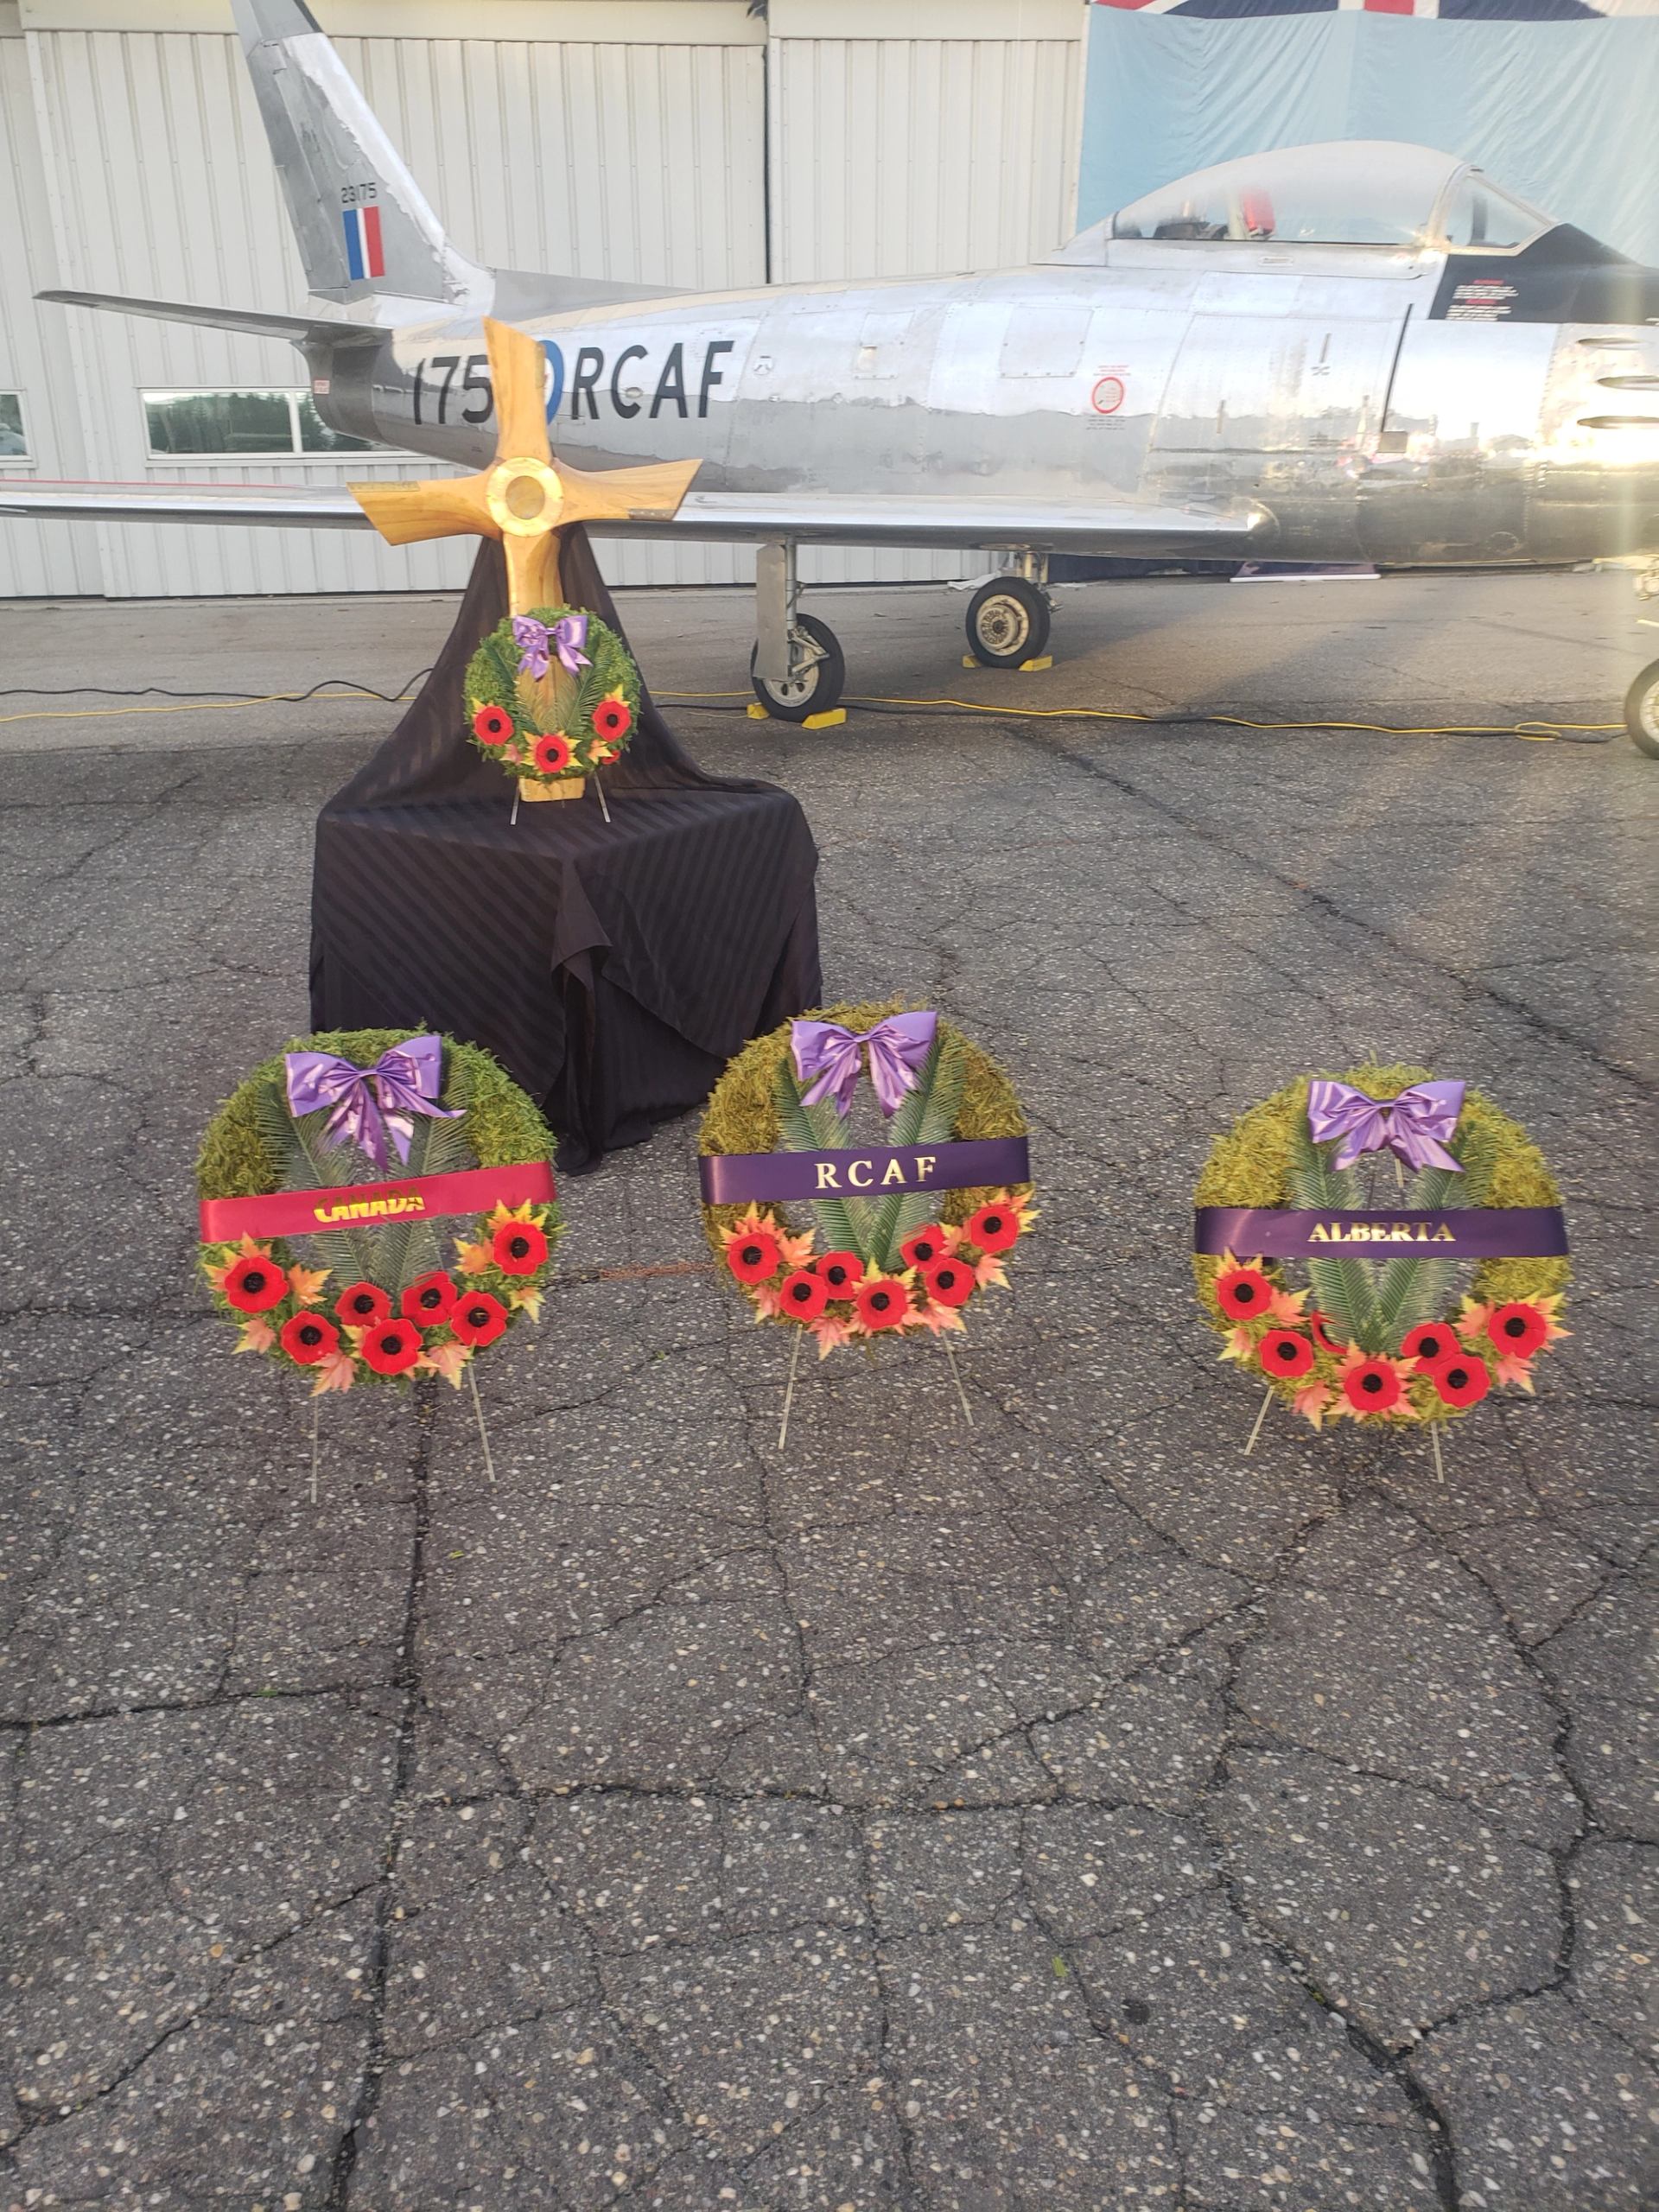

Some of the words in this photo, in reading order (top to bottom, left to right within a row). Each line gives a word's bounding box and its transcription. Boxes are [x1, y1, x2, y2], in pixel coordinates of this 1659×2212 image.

[340, 181, 378, 204] 23175
[413, 353, 495, 425] 175
[570, 340, 735, 421] RCAF
[813, 1155, 937, 1190] RCAF
[313, 1187, 426, 1224] CANADA
[1306, 1221, 1457, 1243] ALBERTA
